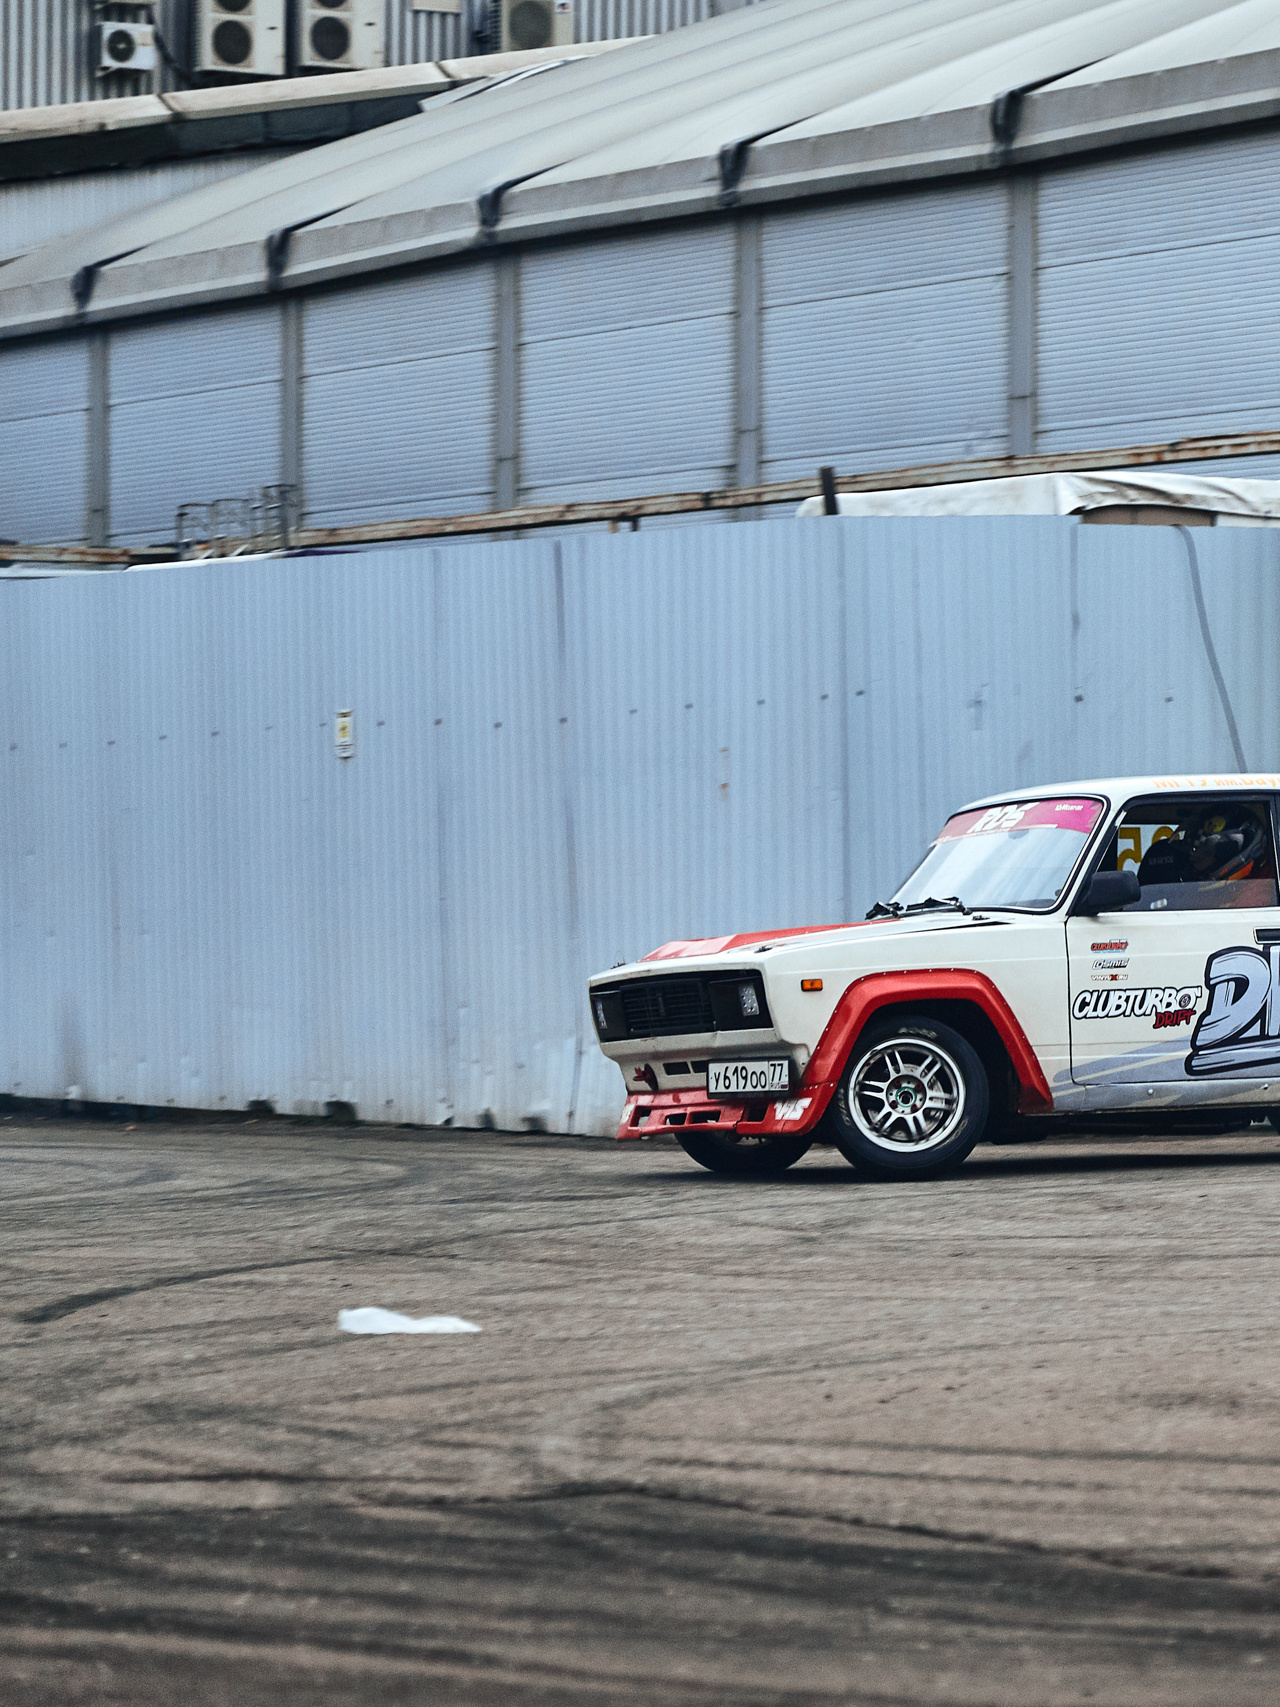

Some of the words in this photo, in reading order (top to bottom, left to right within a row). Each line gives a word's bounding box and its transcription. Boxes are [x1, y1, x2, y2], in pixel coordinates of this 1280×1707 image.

[1072, 985, 1202, 1020] CLUBTURBO
[1153, 1008, 1197, 1030] DRIFT
[769, 1063, 784, 1082] 77
